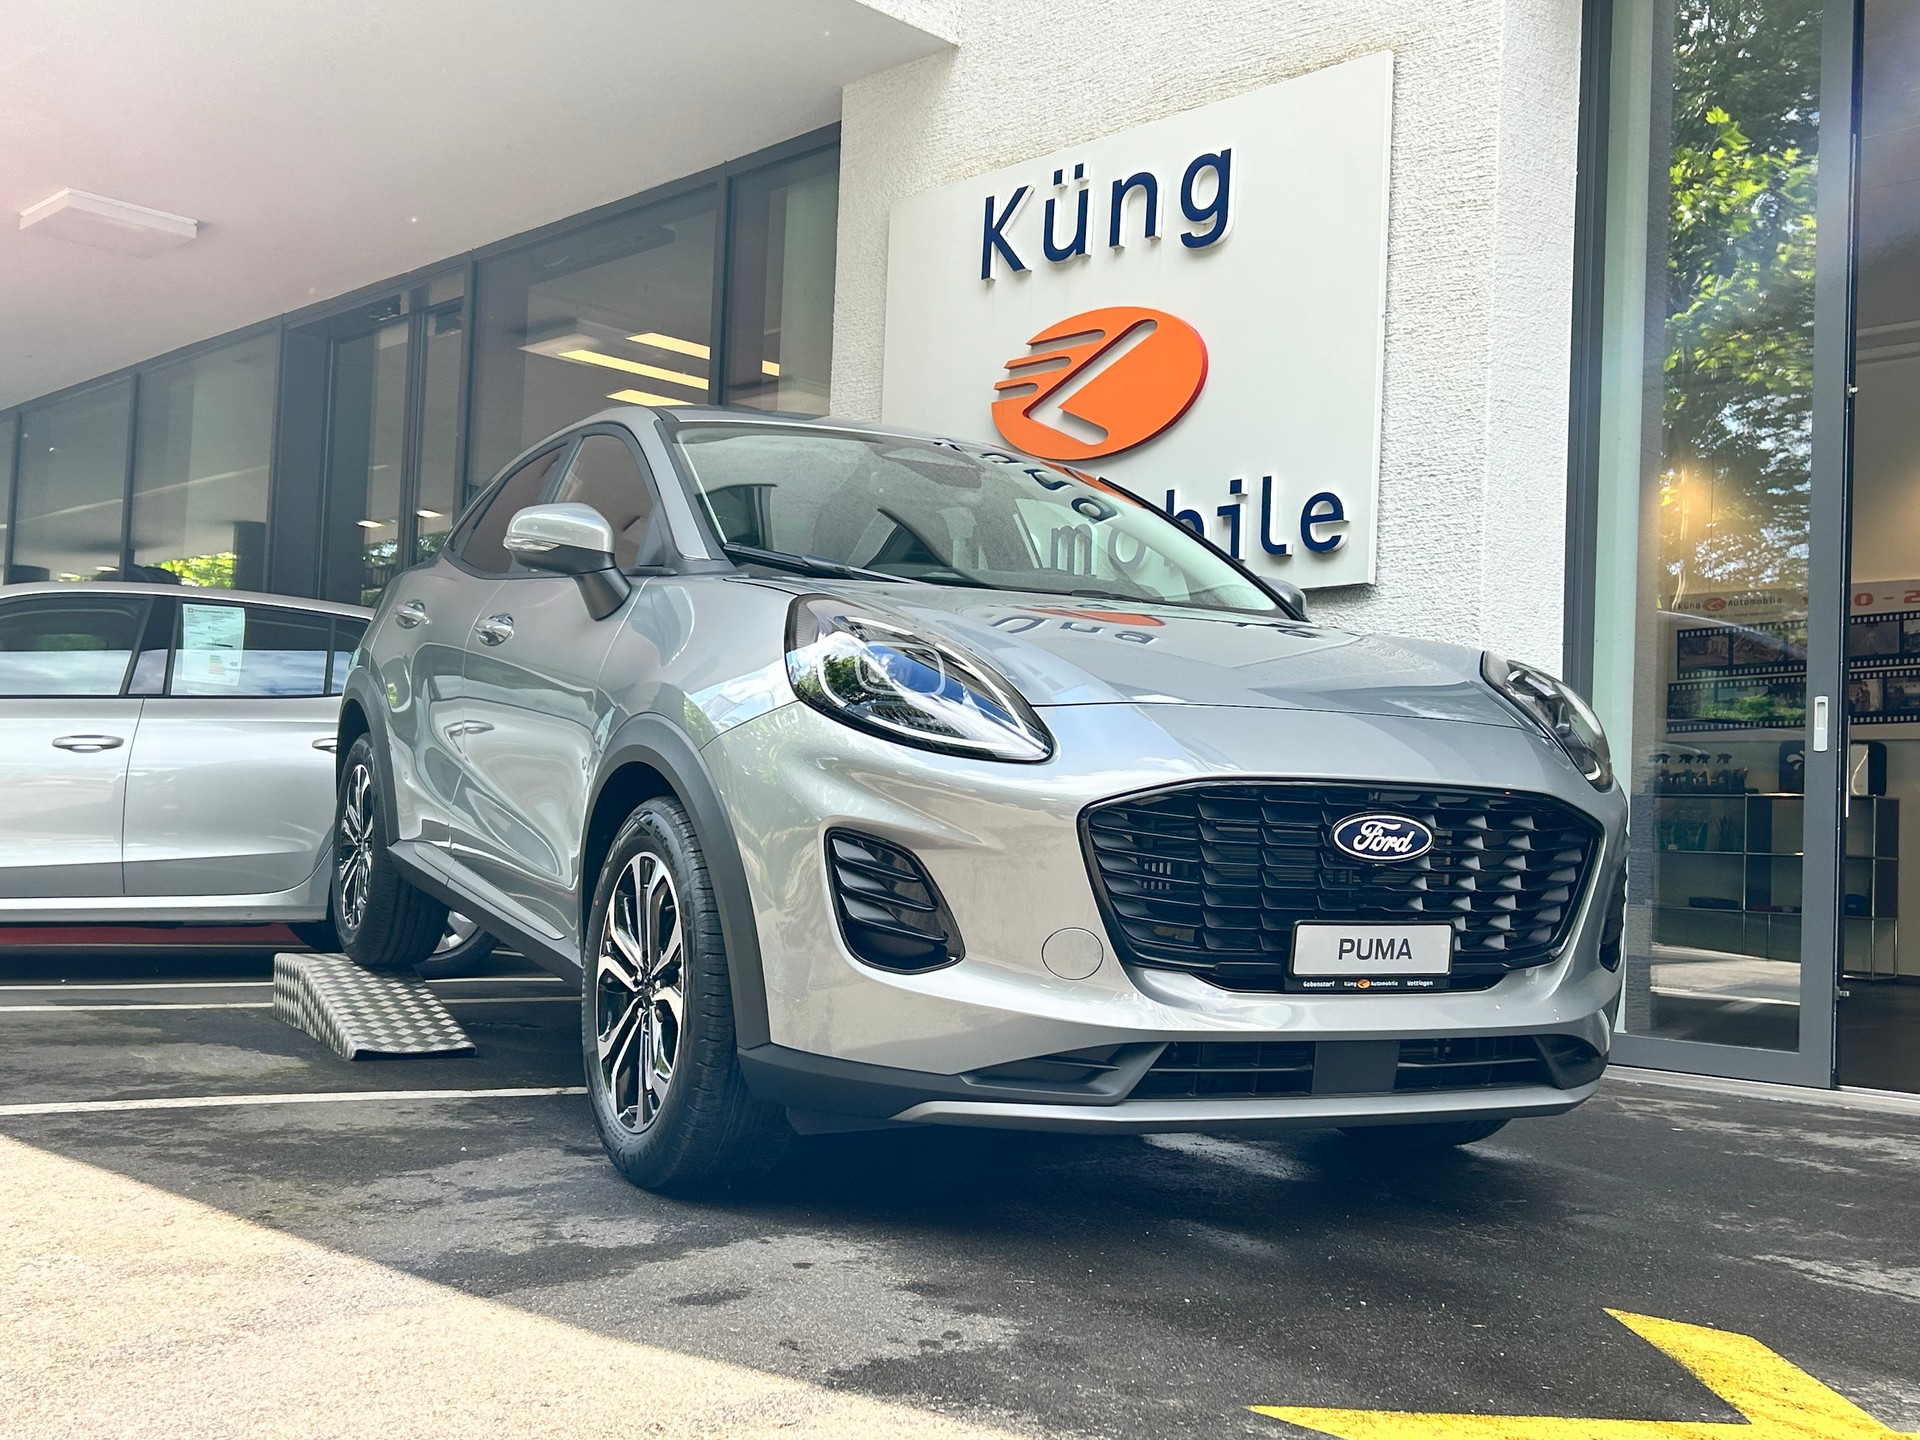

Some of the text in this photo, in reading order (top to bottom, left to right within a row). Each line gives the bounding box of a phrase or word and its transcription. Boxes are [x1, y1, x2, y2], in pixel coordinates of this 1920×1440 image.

[981, 147, 1236, 282] Küng
[1352, 820, 1416, 853] Ford
[1337, 937, 1413, 961] PUMA
[1302, 980, 1336, 988] Gebenstorf
[1343, 980, 1357, 988] Küng
